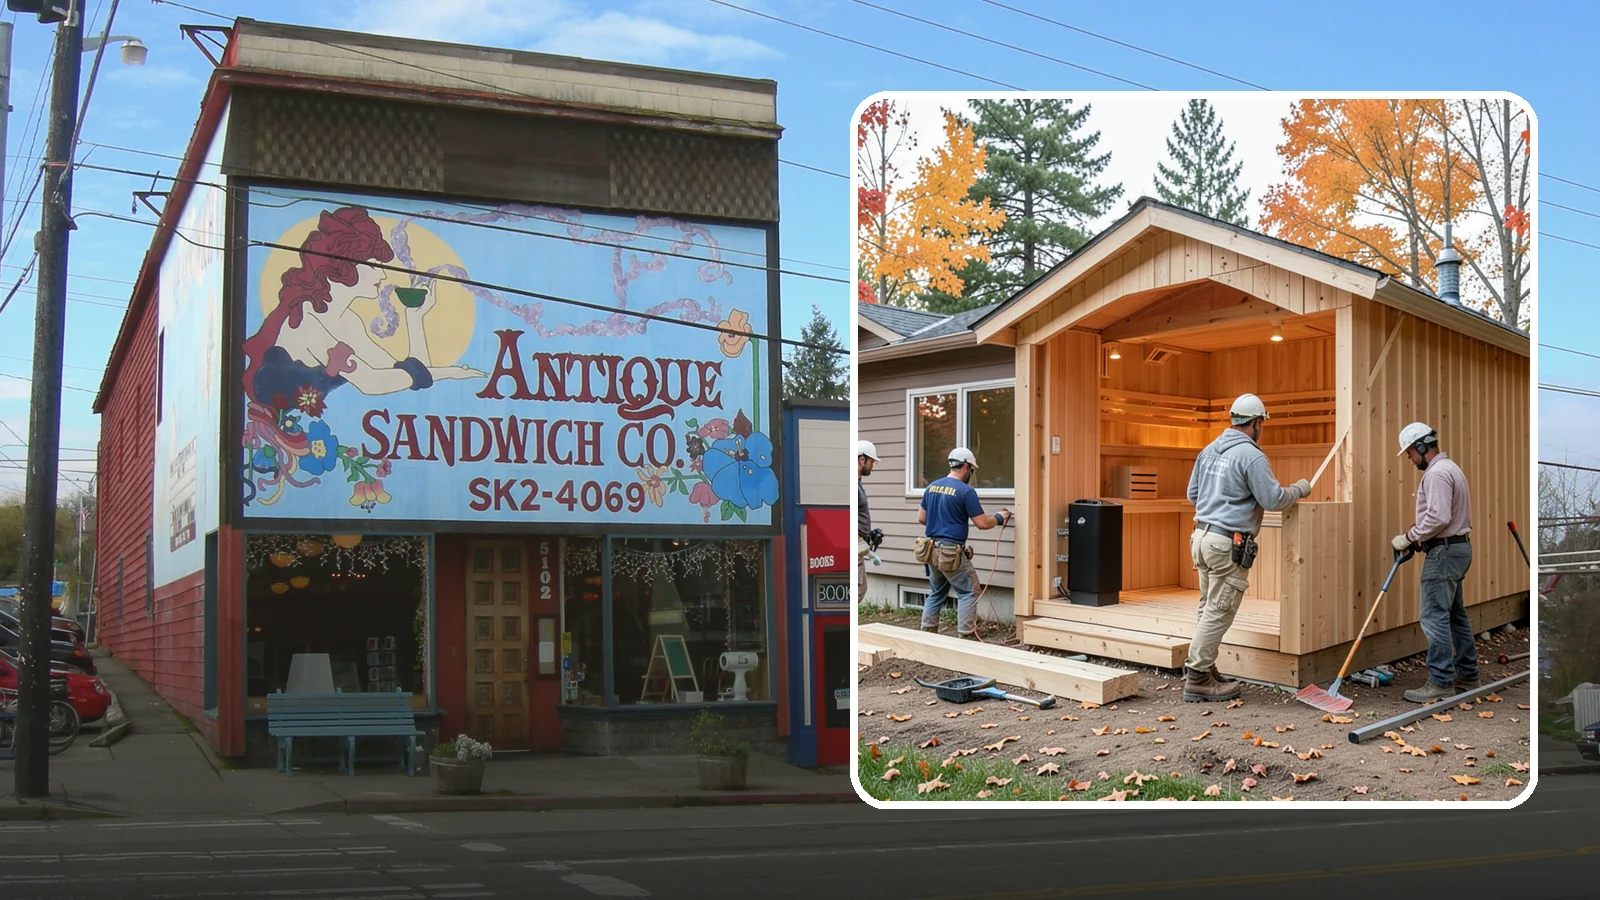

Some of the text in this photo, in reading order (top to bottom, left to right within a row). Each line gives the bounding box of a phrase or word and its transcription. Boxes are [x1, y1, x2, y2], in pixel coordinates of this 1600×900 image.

[475, 329, 724, 421] ANTIQUE
[361, 408, 686, 468] SANDWICH CO.
[468, 476, 646, 513] SK2-4069
[540, 542, 551, 599] 5102
[809, 555, 835, 569] BOOKS
